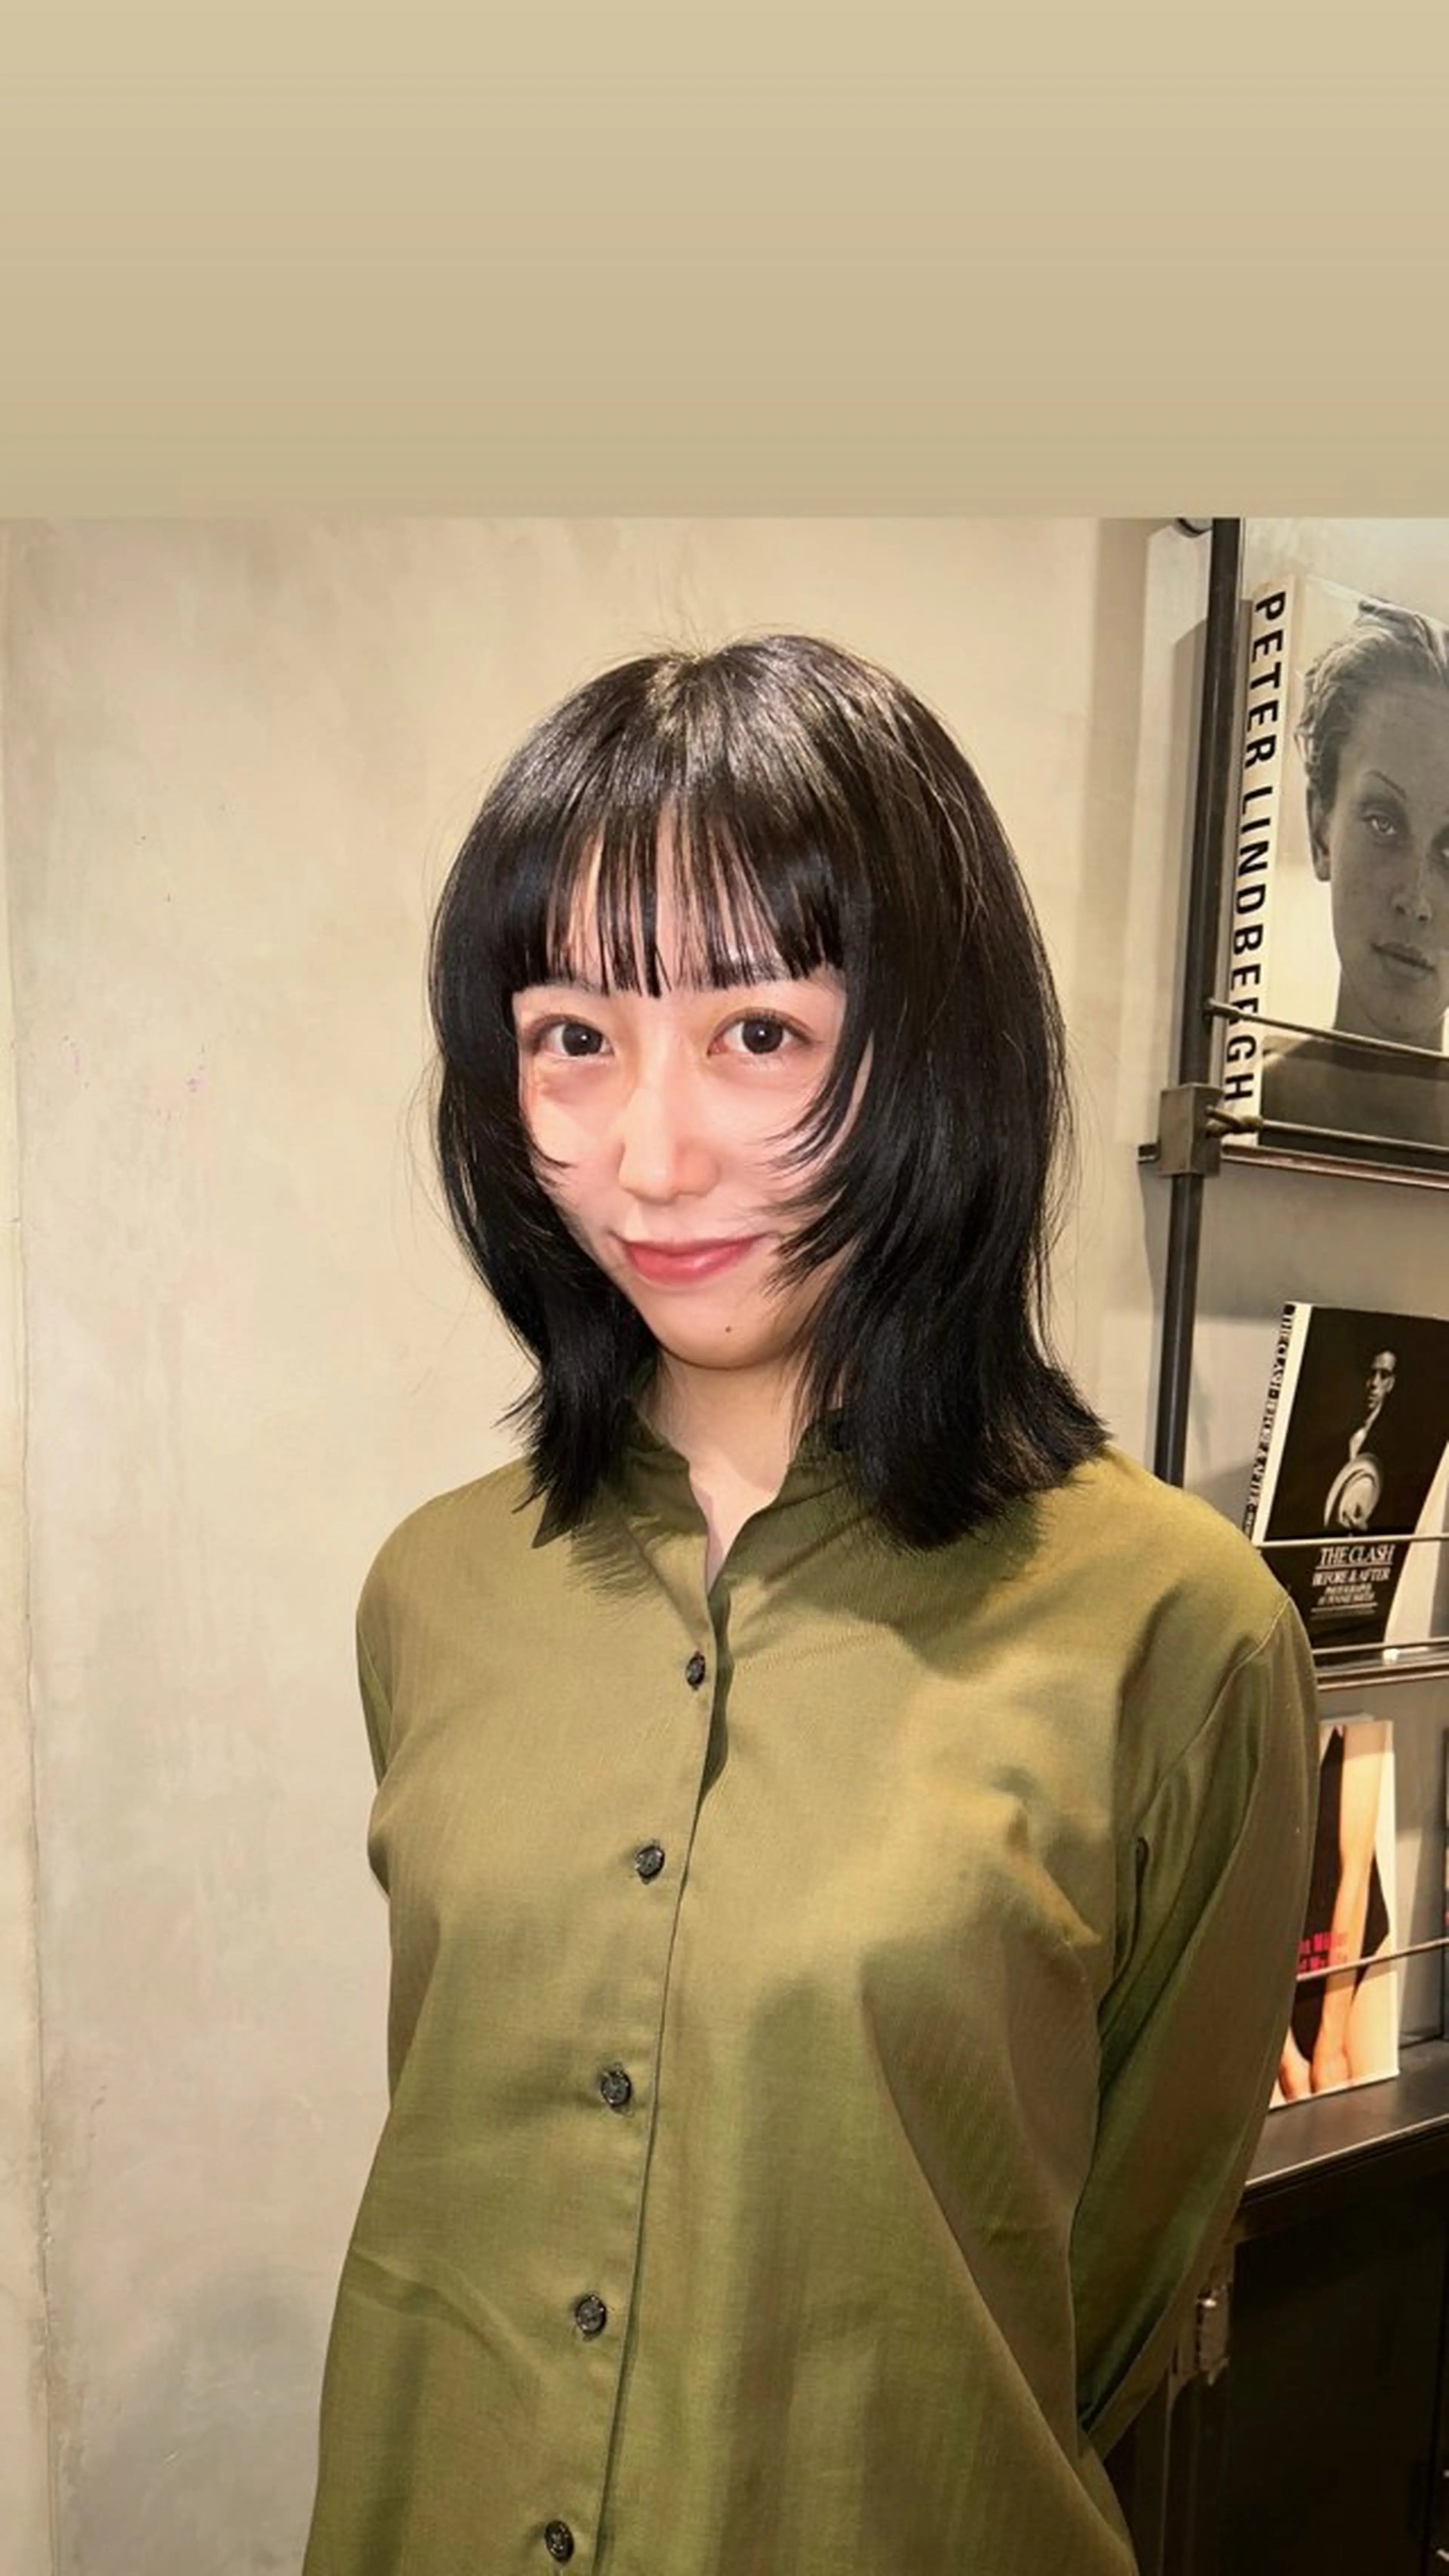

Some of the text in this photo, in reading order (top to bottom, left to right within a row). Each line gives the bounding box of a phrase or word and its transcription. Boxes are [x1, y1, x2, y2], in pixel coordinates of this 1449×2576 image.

[1245, 592, 1286, 769] PETER
[1320, 1544, 1395, 1566] THE CLASH
